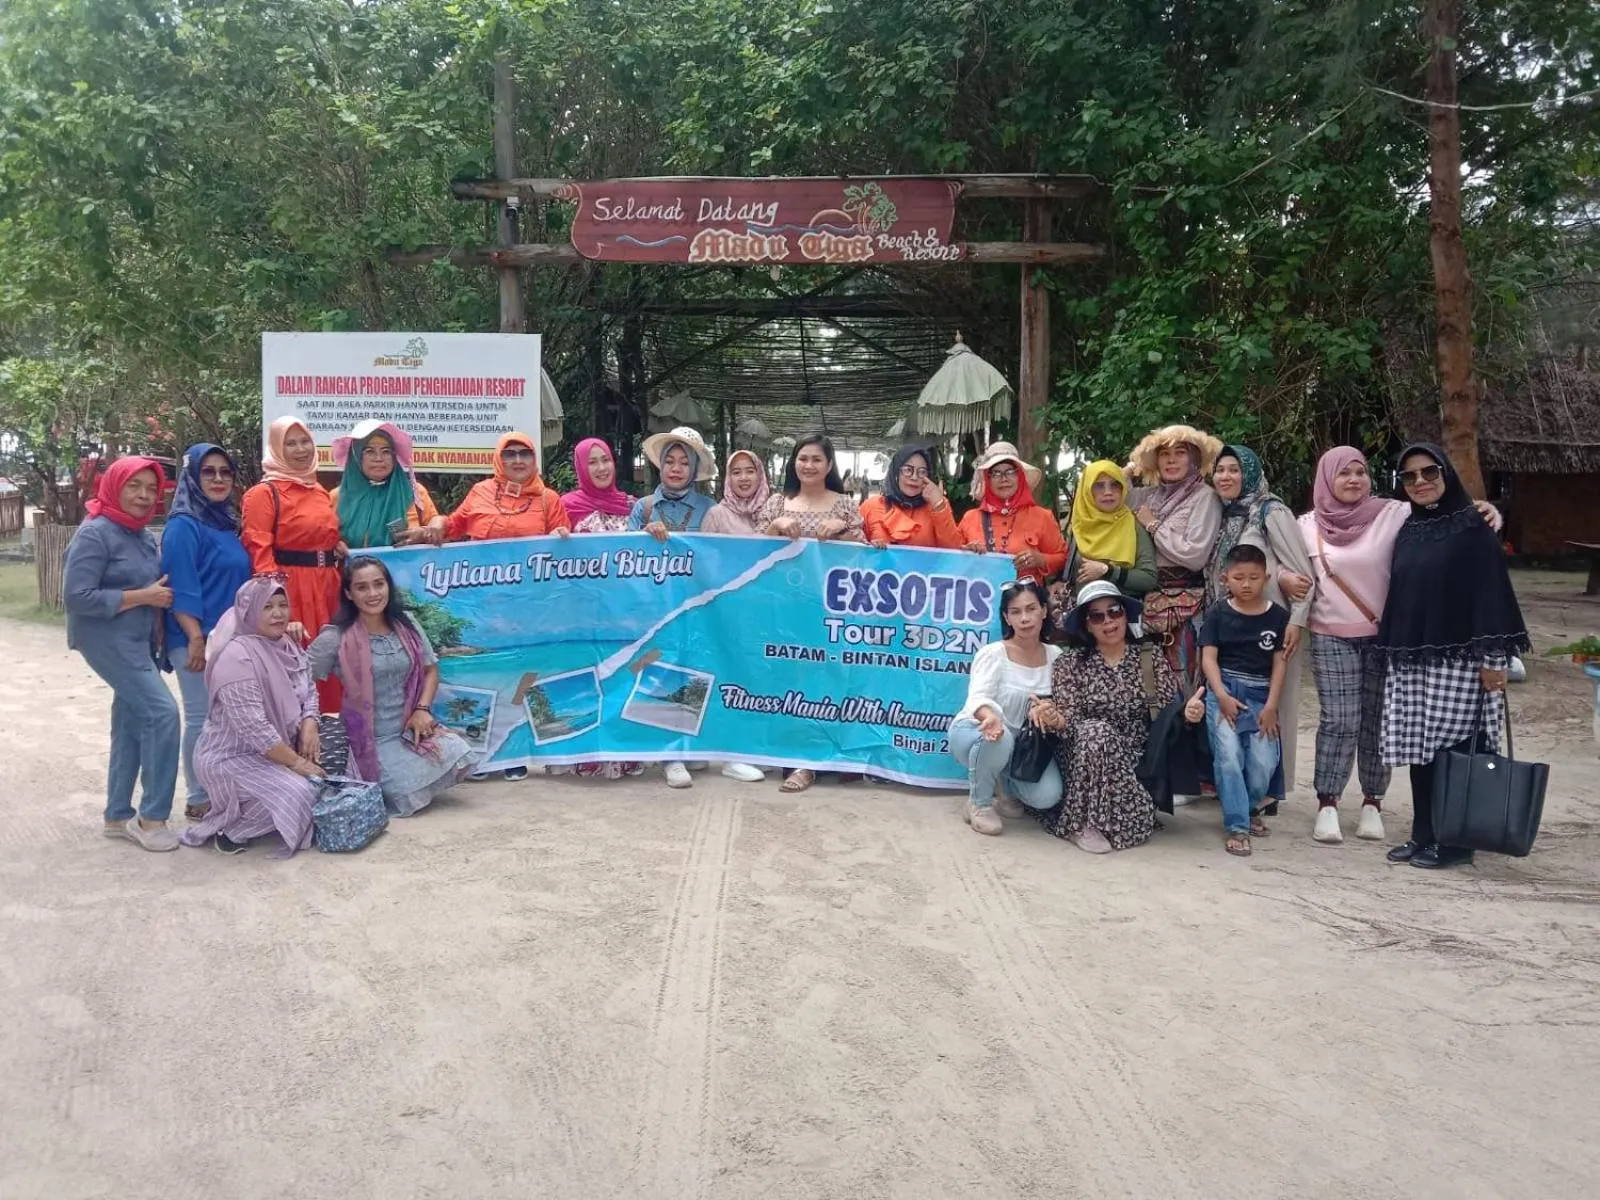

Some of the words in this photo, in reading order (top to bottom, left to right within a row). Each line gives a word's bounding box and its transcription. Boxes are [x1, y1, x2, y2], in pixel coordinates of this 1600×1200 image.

[592, 197, 685, 222] Selamat
[696, 197, 779, 226] Datang
[688, 229, 790, 262] Madu
[797, 231, 873, 262] Tiga
[876, 230, 922, 249] Beach
[900, 244, 960, 261] Resort
[277, 375, 312, 395] DALAM
[315, 376, 358, 396] RANGKA
[360, 376, 411, 396] PROGRAM
[414, 377, 484, 397] PENGHIJAUAN
[486, 378, 526, 398] RESORT
[297, 400, 320, 409] SAAT
[322, 400, 335, 409] INI
[337, 400, 361, 409] AREA
[363, 400, 395, 410] PARKIR
[397, 401, 429, 410] HANYA
[432, 402, 474, 411] TERSEDIA
[476, 402, 507, 411] UNTUK
[307, 411, 334, 419] TAMU
[336, 411, 370, 420] KAMAR
[373, 411, 393, 420] DAN
[395, 412, 426, 420] HANYA
[429, 412, 475, 421] BEBERAPA
[477, 413, 499, 421] UNIT
[306, 421, 347, 431] DARAAN
[407, 423, 446, 432] DENGAN
[449, 424, 513, 433] KETERSEDIAAN
[412, 434, 438, 443] ARKIR
[420, 559, 522, 597] Lyliana
[527, 551, 609, 582] Travel
[613, 548, 693, 584] Binjai
[825, 567, 993, 624] EXSOTIS
[824, 618, 896, 647] Tour
[903, 624, 990, 655] 3D2N
[765, 644, 826, 662] BATAM
[842, 652, 909, 669] BINTAN
[915, 659, 971, 674] ISLAN
[719, 684, 783, 713] Fitness
[780, 690, 839, 721] Mania
[839, 694, 887, 723] With
[886, 701, 955, 733] Ikawan
[893, 734, 935, 753] Binjai
